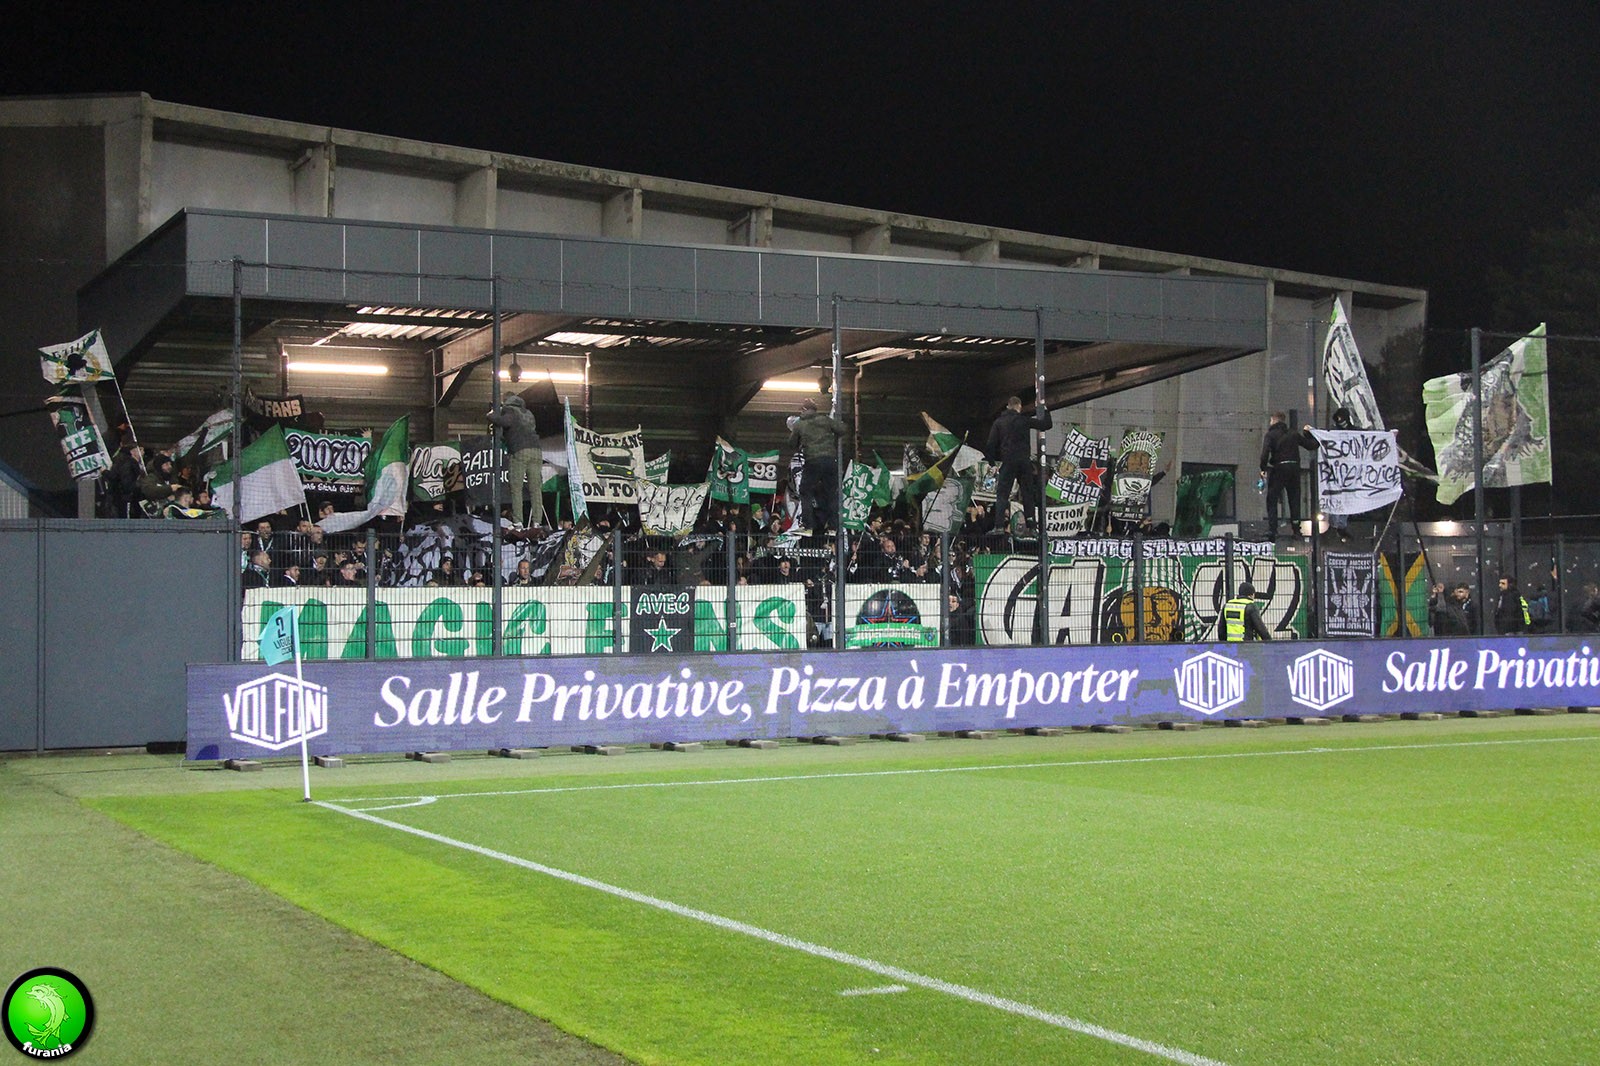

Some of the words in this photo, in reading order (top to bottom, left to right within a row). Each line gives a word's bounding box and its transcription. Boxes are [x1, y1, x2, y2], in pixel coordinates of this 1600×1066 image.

[265, 399, 301, 418] FANS
[575, 429, 611, 447] MAGIC
[612, 433, 643, 448] FANS
[1064, 441, 1109, 461] ANGELS
[753, 463, 777, 480] 98
[582, 482, 606, 496] ON
[609, 483, 638, 497] TO
[1060, 490, 1097, 507] PARIS
[1047, 507, 1084, 520] ECTION
[1046, 520, 1084, 532] ERMON
[636, 592, 690, 616] AVEC
[275, 616, 287, 638] 2
[585, 597, 800, 652] FNS
[273, 636, 291, 650] LIGUE
[1382, 647, 1468, 693] Salle
[374, 670, 506, 728] Salle
[515, 667, 752, 723] Privative,
[764, 664, 887, 715] Pizza
[896, 659, 925, 709] à
[934, 662, 1139, 719] Emporter
